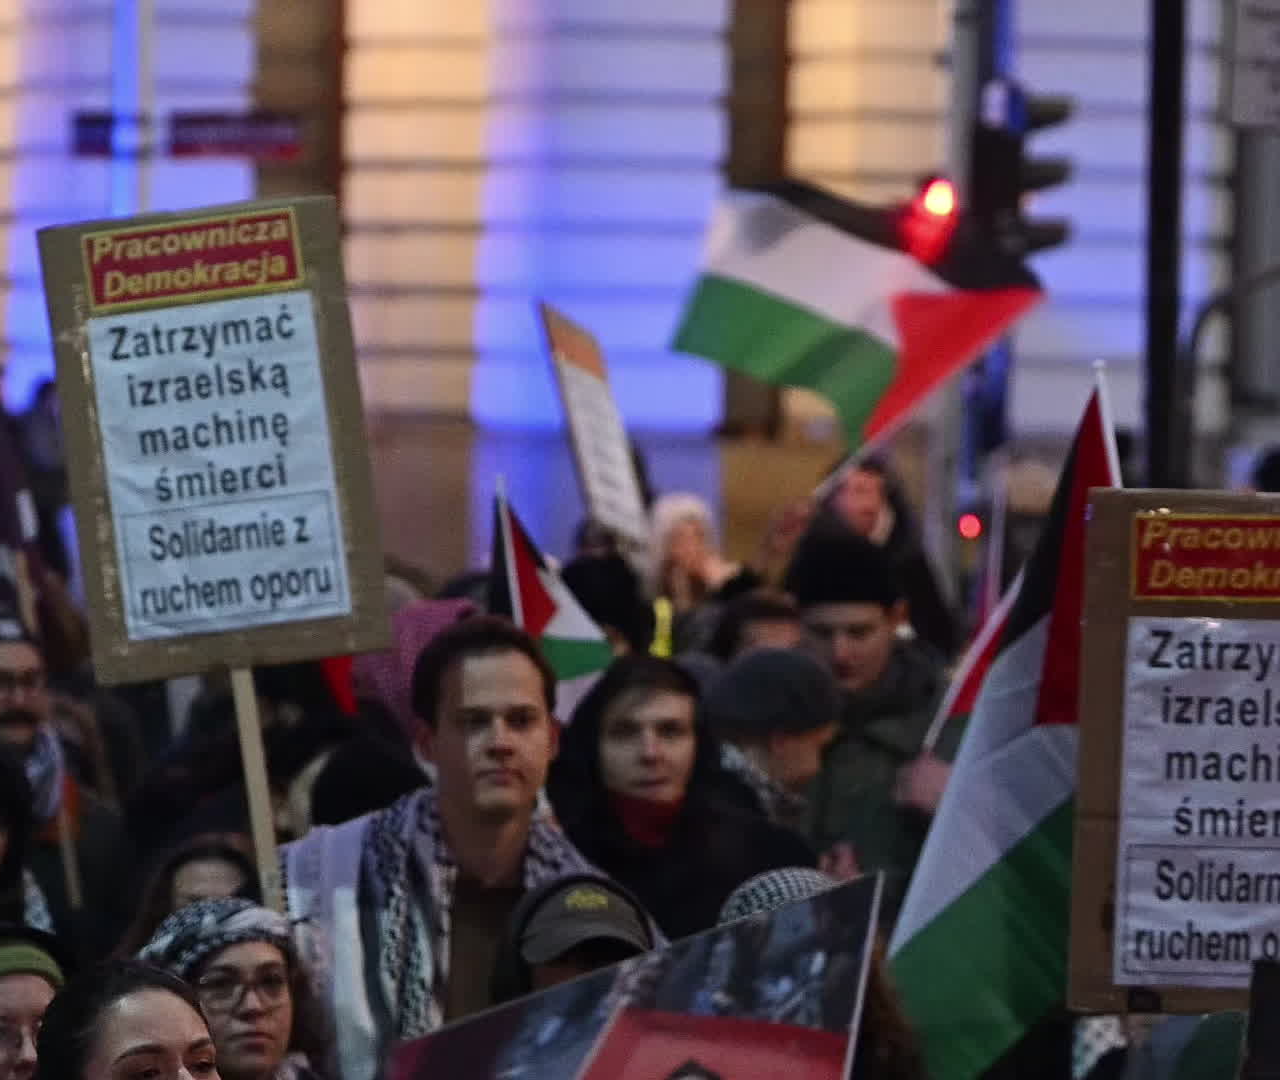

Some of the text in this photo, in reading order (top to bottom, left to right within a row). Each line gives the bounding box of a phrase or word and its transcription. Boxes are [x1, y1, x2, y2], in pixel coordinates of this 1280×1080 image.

[92, 216, 290, 264] Pracownicza
[103, 252, 288, 298] Demokracja
[108, 304, 296, 361] Zatrzymać
[126, 359, 291, 408] izraelską
[138, 410, 290, 455] machinę
[154, 453, 288, 501] śmierci
[148, 511, 312, 562] Solidarnie z
[139, 565, 333, 616] ruchem oporu
[1134, 920, 1251, 962] ruchem
